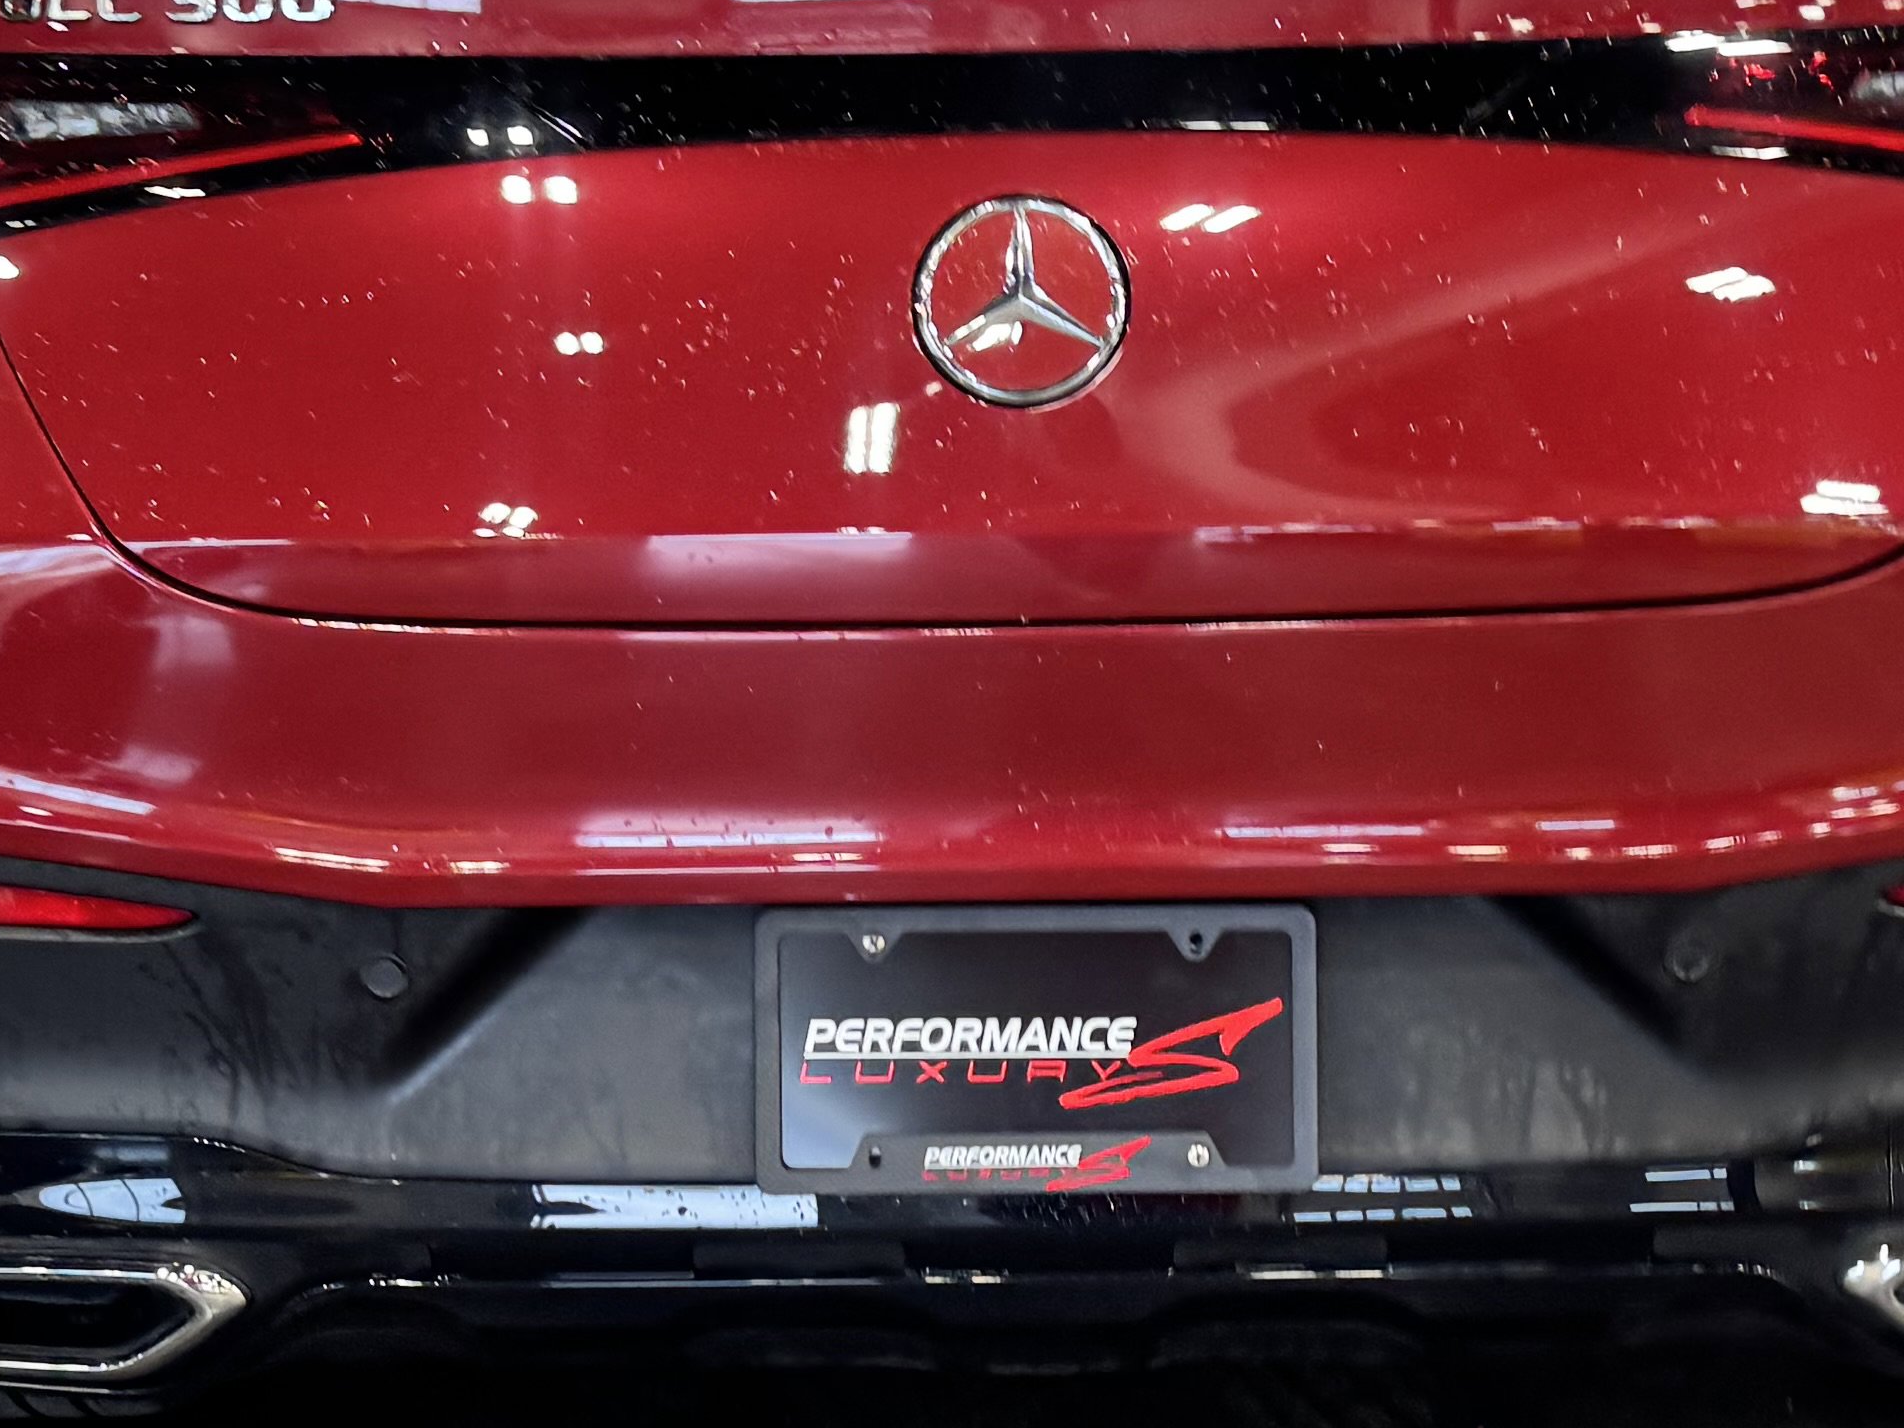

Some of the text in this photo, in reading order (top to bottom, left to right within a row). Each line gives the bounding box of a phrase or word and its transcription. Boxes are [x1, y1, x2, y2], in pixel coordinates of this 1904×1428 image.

[803, 1016, 1138, 1057] PERFORMANCE
[800, 1060, 1122, 1084] LUXURY
[923, 1143, 1083, 1168] PERFORMANCE
